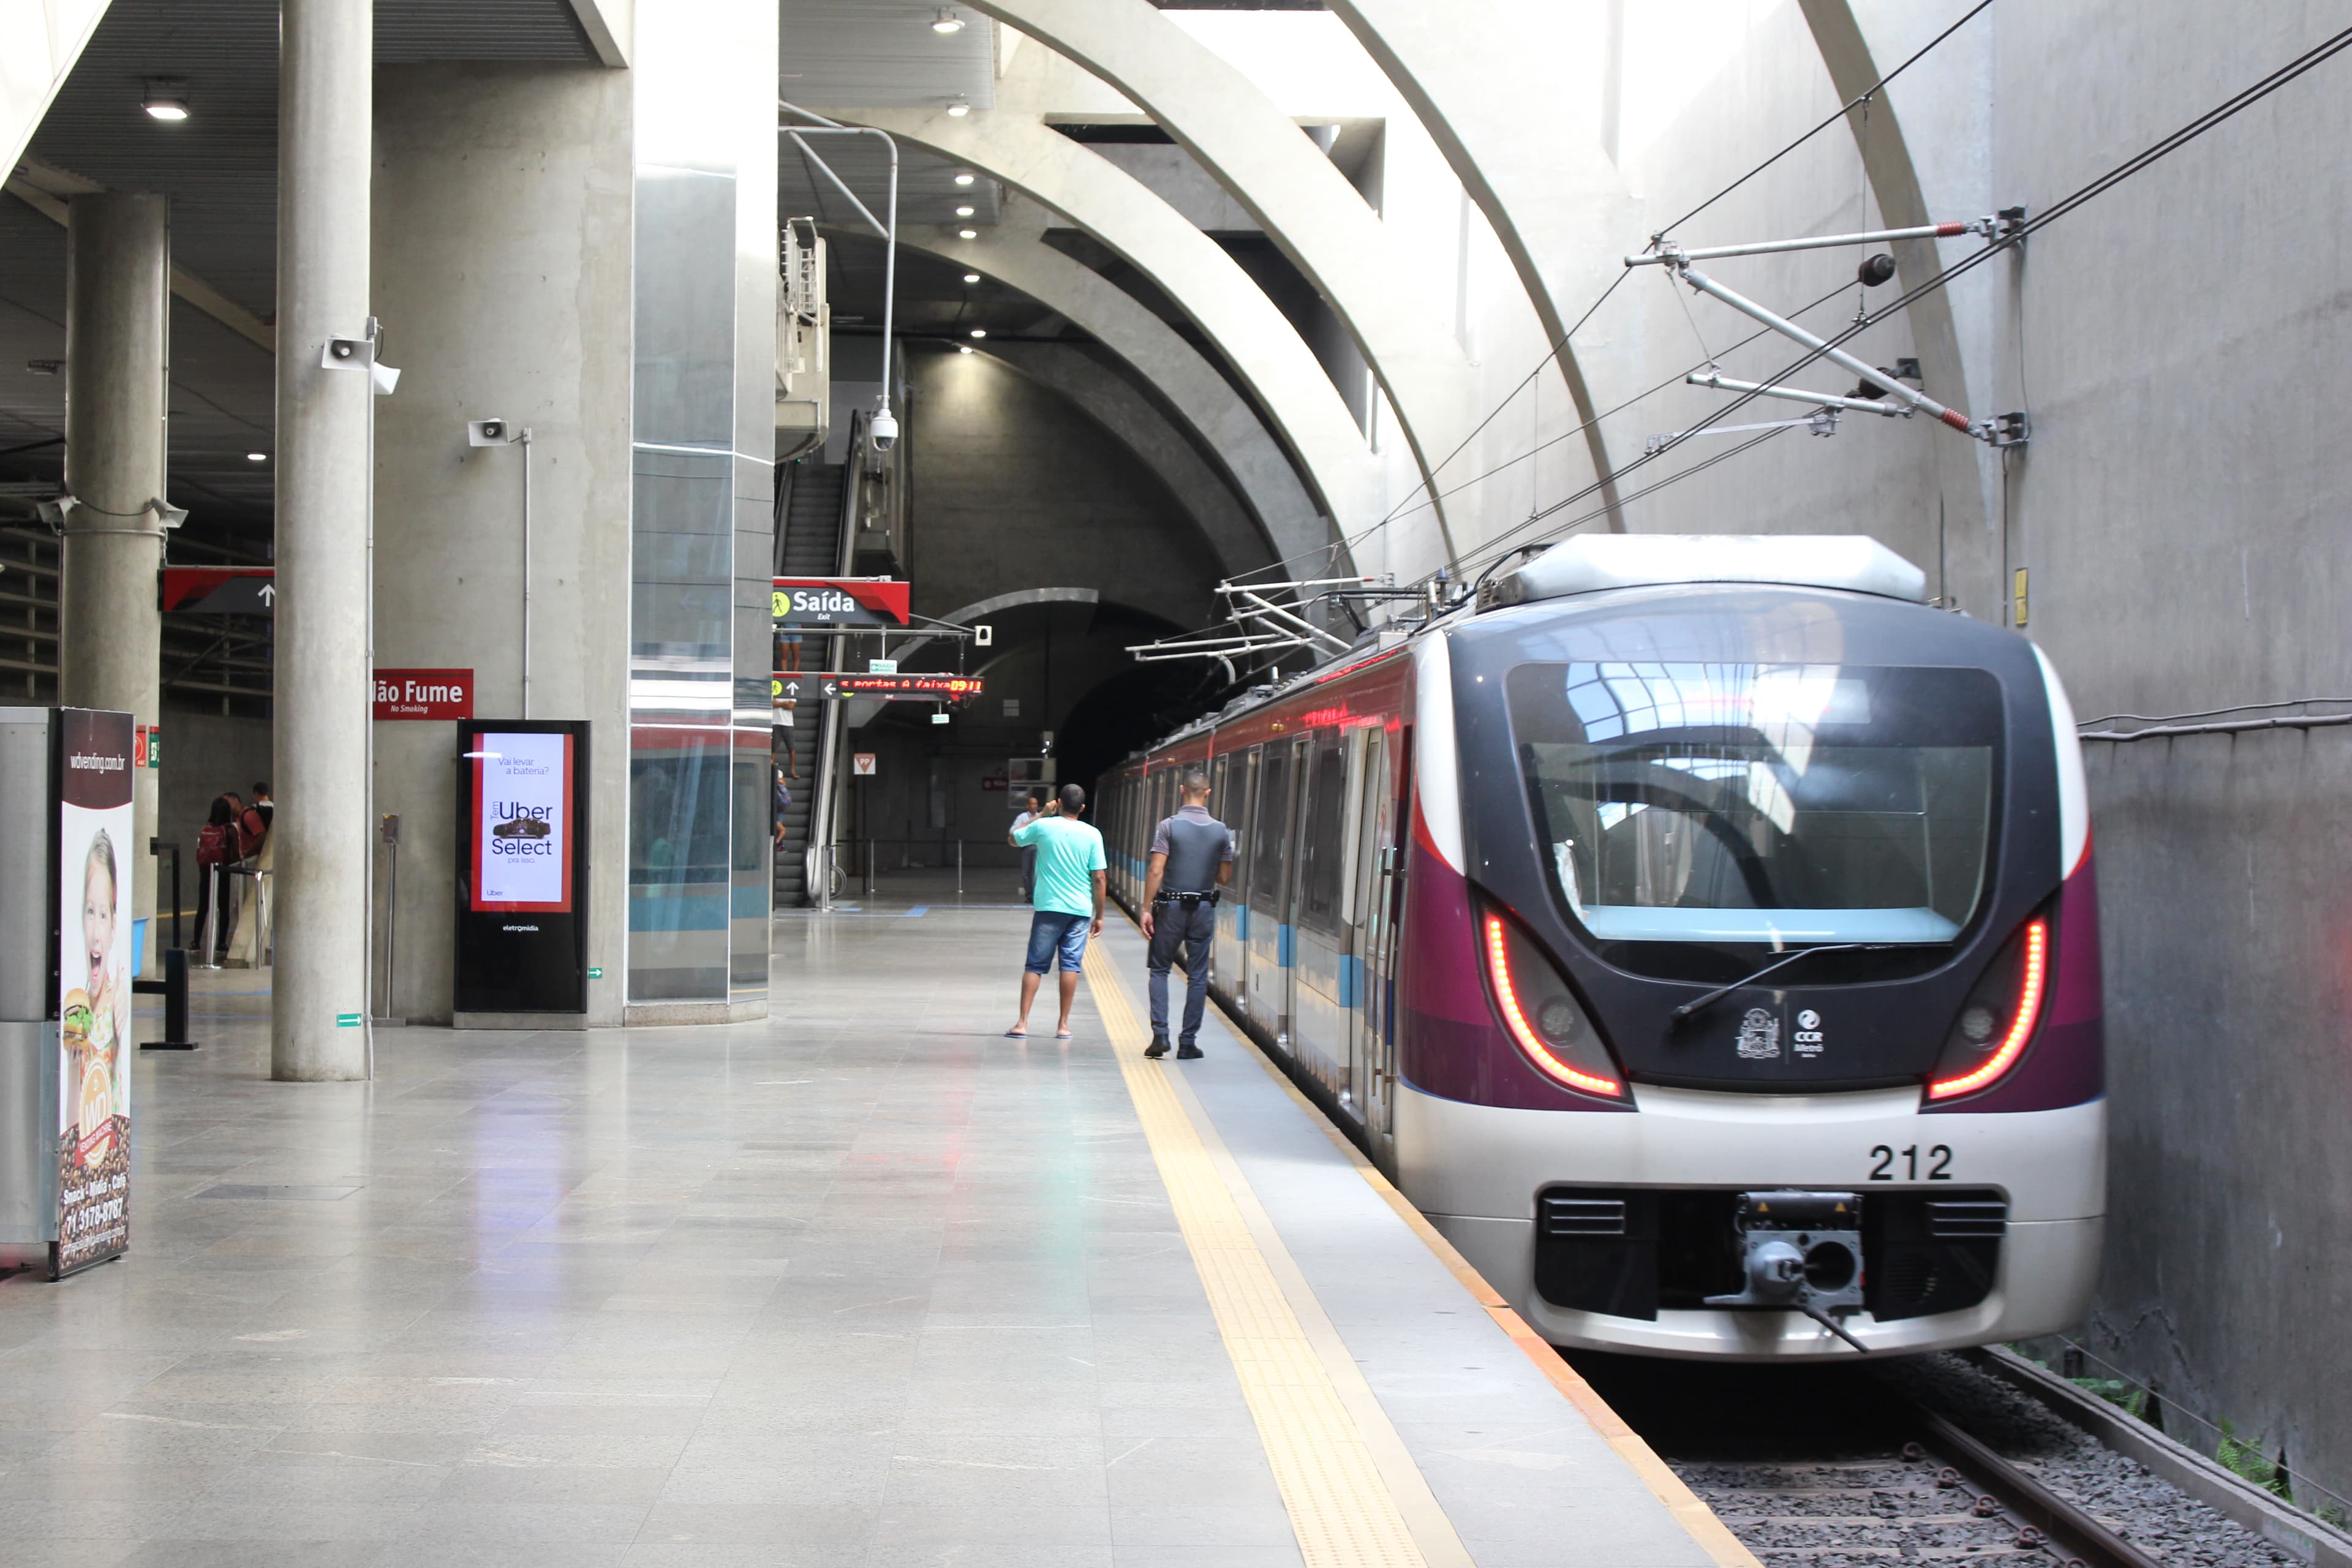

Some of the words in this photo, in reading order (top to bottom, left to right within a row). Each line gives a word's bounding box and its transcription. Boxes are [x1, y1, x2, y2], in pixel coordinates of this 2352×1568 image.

[793, 590, 855, 612] Saída
[405, 680, 463, 703] Fume
[951, 681, 981, 691] 09:11
[400, 705, 428, 714] Smoking
[70, 752, 125, 774] wdvending.com.br
[513, 757, 534, 766] levar
[513, 766, 549, 775] bateria?
[500, 801, 553, 820] Uber
[492, 839, 552, 855] Select
[1795, 1031, 1823, 1042] CCR
[85, 1091, 106, 1136] WD
[1869, 1144, 1952, 1180] 212
[64, 1185, 85, 1205] Snack
[112, 1172, 126, 1189] Café
